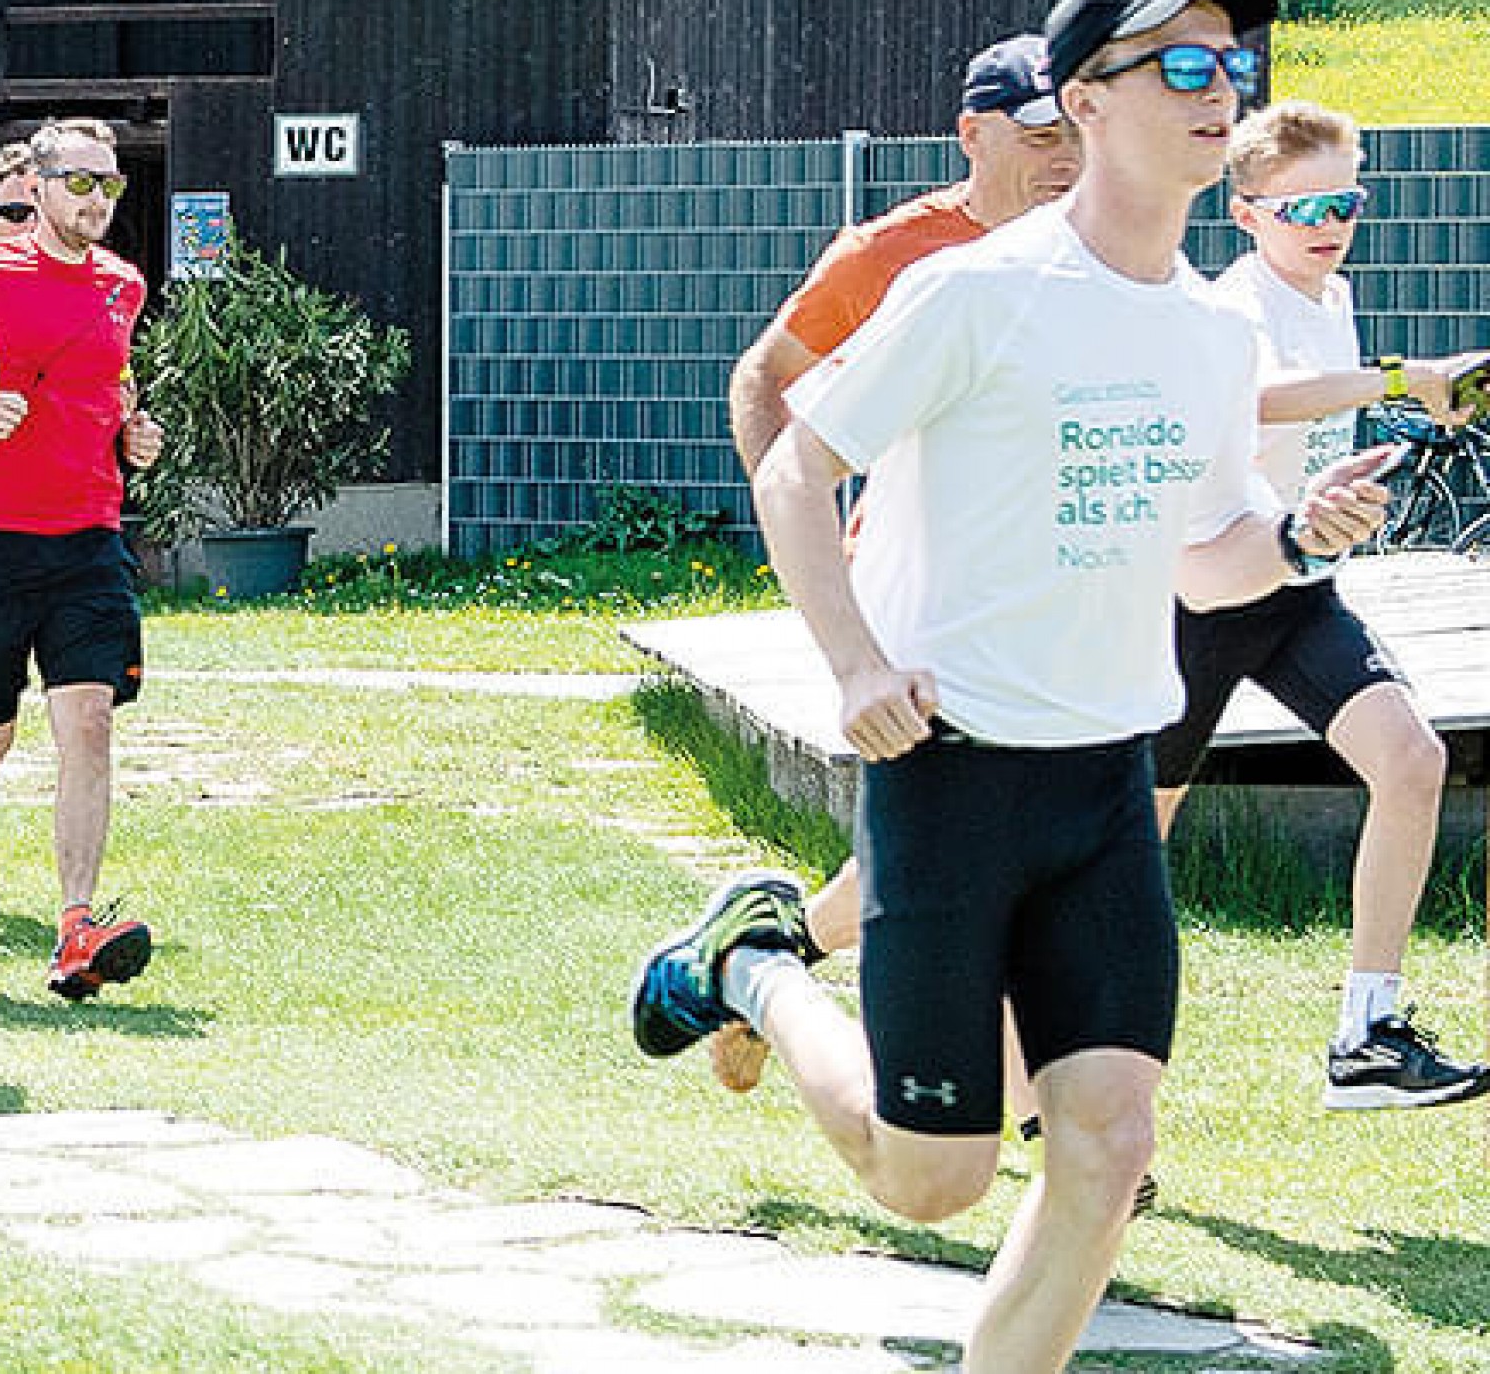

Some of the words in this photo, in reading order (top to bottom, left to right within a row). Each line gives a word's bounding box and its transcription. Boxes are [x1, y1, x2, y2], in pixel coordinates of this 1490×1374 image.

[284, 126, 347, 161] WC
[1060, 415, 1187, 450] Ronaldo
[1056, 491, 1108, 525] als
